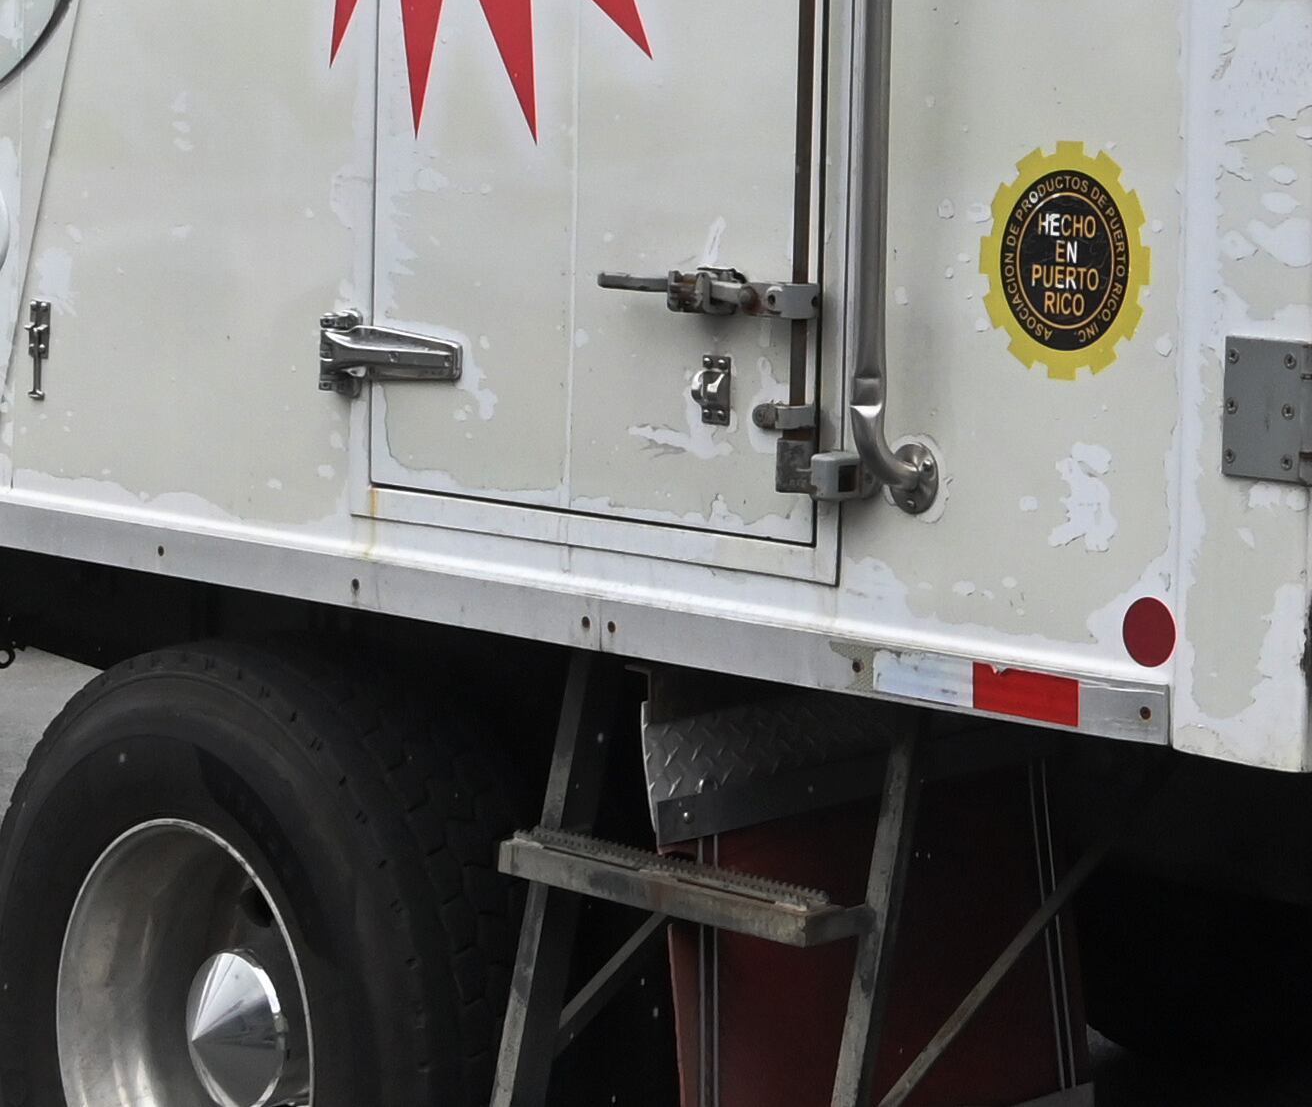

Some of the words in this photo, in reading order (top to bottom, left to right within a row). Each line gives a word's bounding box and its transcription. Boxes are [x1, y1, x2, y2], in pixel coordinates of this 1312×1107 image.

[1006, 224, 1020, 247] DE
[1015, 175, 1089, 222] PRODUCTOS
[1090, 188, 1108, 209] DE
[1105, 206, 1126, 278] PUERTO
[1038, 213, 1096, 238] HECHO
[1055, 240, 1078, 264] EN
[1031, 264, 1099, 292] PUERTO
[1044, 291, 1085, 317] RICO
